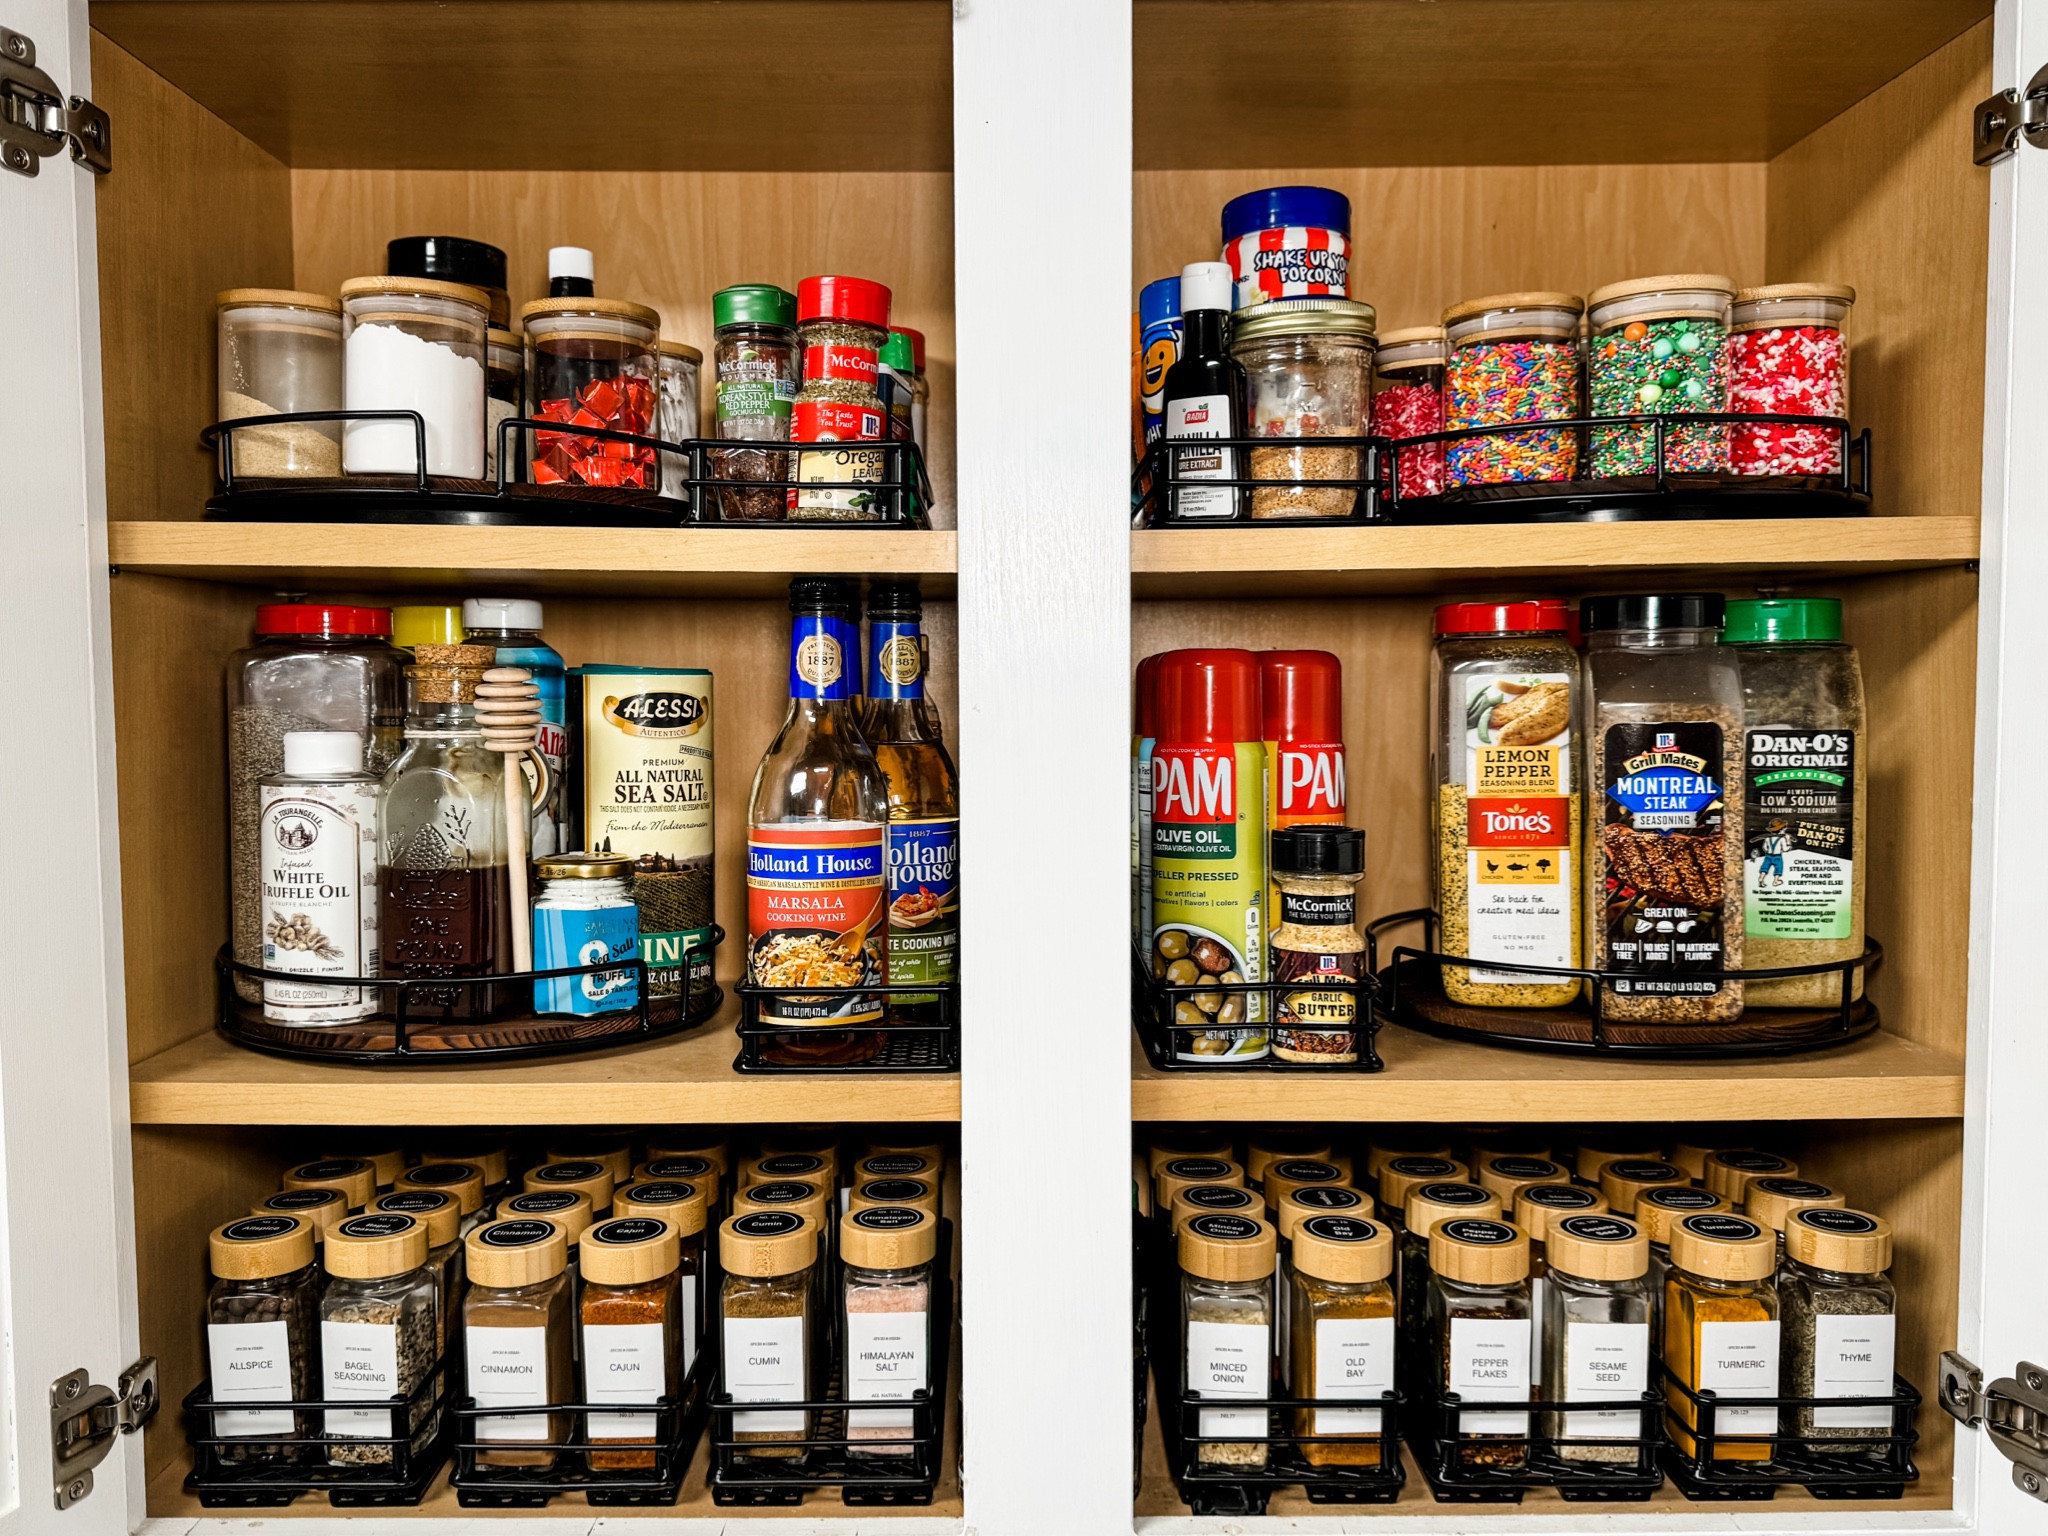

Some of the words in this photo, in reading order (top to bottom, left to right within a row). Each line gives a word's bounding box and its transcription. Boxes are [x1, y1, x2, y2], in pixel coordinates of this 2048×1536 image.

[1254, 248, 1307, 272] SHAKE
[1308, 249, 1329, 267] UP
[1280, 266, 1346, 290] POPCORN!
[718, 359, 777, 374] McCormick
[719, 392, 774, 404] KOREAN-STYLE
[725, 401, 740, 411] RED
[740, 400, 771, 409] PEPPER
[729, 408, 765, 416] GOCHUGARU
[821, 409, 834, 419] The
[835, 409, 854, 420] Taste
[1185, 411, 1208, 422] BADIA
[820, 418, 834, 427] You
[1190, 459, 1218, 469] EXTRACT
[807, 655, 835, 666] 1887
[623, 698, 698, 720] ALESSI
[640, 728, 687, 737] AUTENTICO
[1751, 733, 1848, 753] DAN-O'S
[1484, 749, 1550, 763] LEMON
[1630, 754, 1657, 770] Grill
[1661, 753, 1700, 769] Mates
[1750, 754, 1848, 767] ORIGINAL
[642, 758, 685, 767] PREMIUM
[615, 770, 643, 783] ALL
[647, 768, 704, 783] NATURAL
[1483, 764, 1552, 778] PEPPER
[1766, 771, 1834, 781] SEASONING
[1152, 756, 1232, 817] PAM
[1479, 779, 1527, 787] SEASONING
[1617, 776, 1717, 795] MONTREAL
[614, 784, 657, 804] SEA
[663, 782, 705, 803] SALT
[1644, 796, 1688, 810] STEAK
[1760, 795, 1786, 807] LOW
[1790, 795, 1837, 807] SODIUM
[609, 805, 620, 813] SALT
[620, 805, 633, 813] DOES
[643, 804, 663, 813] CONTAIN
[278, 807, 324, 827] TOURANGELLE
[1481, 810, 1552, 834] Tone's
[1640, 815, 1691, 825] SEASONING
[605, 819, 631, 834] From
[631, 820, 647, 831] the
[649, 818, 708, 832] Mediterranean
[1819, 823, 1846, 834] SOME
[908, 830, 931, 838] 1887
[1156, 828, 1192, 843] OLIVE
[1195, 830, 1222, 844] OIL
[1796, 827, 1845, 844] DAN-O'S
[1172, 844, 1195, 852] VIRGIN
[1196, 845, 1218, 853] OLIVE
[1218, 845, 1232, 853] OIL
[1805, 838, 1820, 848] ON
[280, 858, 313, 870] Infused
[749, 852, 810, 873] Holland
[816, 854, 873, 874] House
[273, 869, 325, 884] WHITE
[1187, 872, 1239, 881] PRESSED
[262, 882, 315, 899] TRUFFLE
[319, 884, 350, 899] OIL
[777, 881, 801, 889] MARSALA
[801, 881, 819, 889] STYLE
[820, 881, 835, 889] WINE
[1174, 889, 1207, 898] artificial
[1492, 894, 1506, 904] See
[1508, 894, 1529, 903] back
[1531, 894, 1544, 903] for
[299, 900, 333, 908] BLANCHE
[767, 896, 845, 910] MARSALA
[1184, 899, 1210, 907] flavors
[1216, 899, 1239, 907] colors
[1287, 896, 1352, 913] McCormick
[1288, 911, 1299, 919] THE
[1299, 911, 1319, 920] TASTE
[1319, 912, 1334, 920] YOU
[1477, 907, 1513, 915] creative
[1515, 907, 1535, 915] meal
[1537, 906, 1560, 915] ideas
[1644, 907, 1673, 918] GREAT
[1673, 907, 1688, 918] ON
[766, 912, 814, 923] COOKING
[817, 912, 847, 922] WINE
[410, 916, 449, 936] ONE
[902, 936, 942, 950] COOKING
[942, 933, 957, 947] WINE
[1611, 942, 1638, 952] GLUTEN
[611, 936, 634, 959] Salt
[1643, 943, 1654, 952] NO
[1676, 943, 1686, 952] NO
[1686, 943, 1721, 952] ARTIFICIAL
[1616, 951, 1634, 960] FREE
[1645, 952, 1668, 961] ADDED
[1684, 952, 1713, 961] FLAVORS
[590, 969, 636, 984] TRUFFLE
[669, 970, 681, 982] LB.
[302, 990, 328, 1000] (250mL)
[587, 989, 605, 997] SALE
[1311, 992, 1343, 1003] GARLIC
[782, 1006, 788, 1016] 16
[794, 1007, 800, 1017] OZ
[1297, 1002, 1355, 1017] BUTTER
[1205, 1030, 1219, 1041] NET
[1219, 1030, 1230, 1041] WT
[1208, 1223, 1245, 1232] Minced
[1209, 1227, 1240, 1236] Onion
[748, 1356, 781, 1367] CUMIN
[859, 1351, 915, 1361] HIMALAYAN
[1838, 1352, 1873, 1364] THYME
[228, 1360, 274, 1372] ALLSPICE
[344, 1361, 374, 1372] BAGEL
[609, 1362, 641, 1373] CAJUN
[875, 1362, 899, 1372] SALT
[1209, 1362, 1248, 1374] MINCED
[1345, 1357, 1366, 1368] OLD
[1471, 1357, 1509, 1368] PEPPER
[1588, 1361, 1628, 1372] SESAME
[1717, 1359, 1766, 1371] TURMERIC
[480, 1364, 534, 1375] CINNAMON
[1345, 1368, 1366, 1379] BAY
[1471, 1368, 1508, 1379] FLAKES
[333, 1371, 386, 1383] SEASONING
[1212, 1373, 1245, 1384] ONION
[1595, 1372, 1621, 1383] SEED
